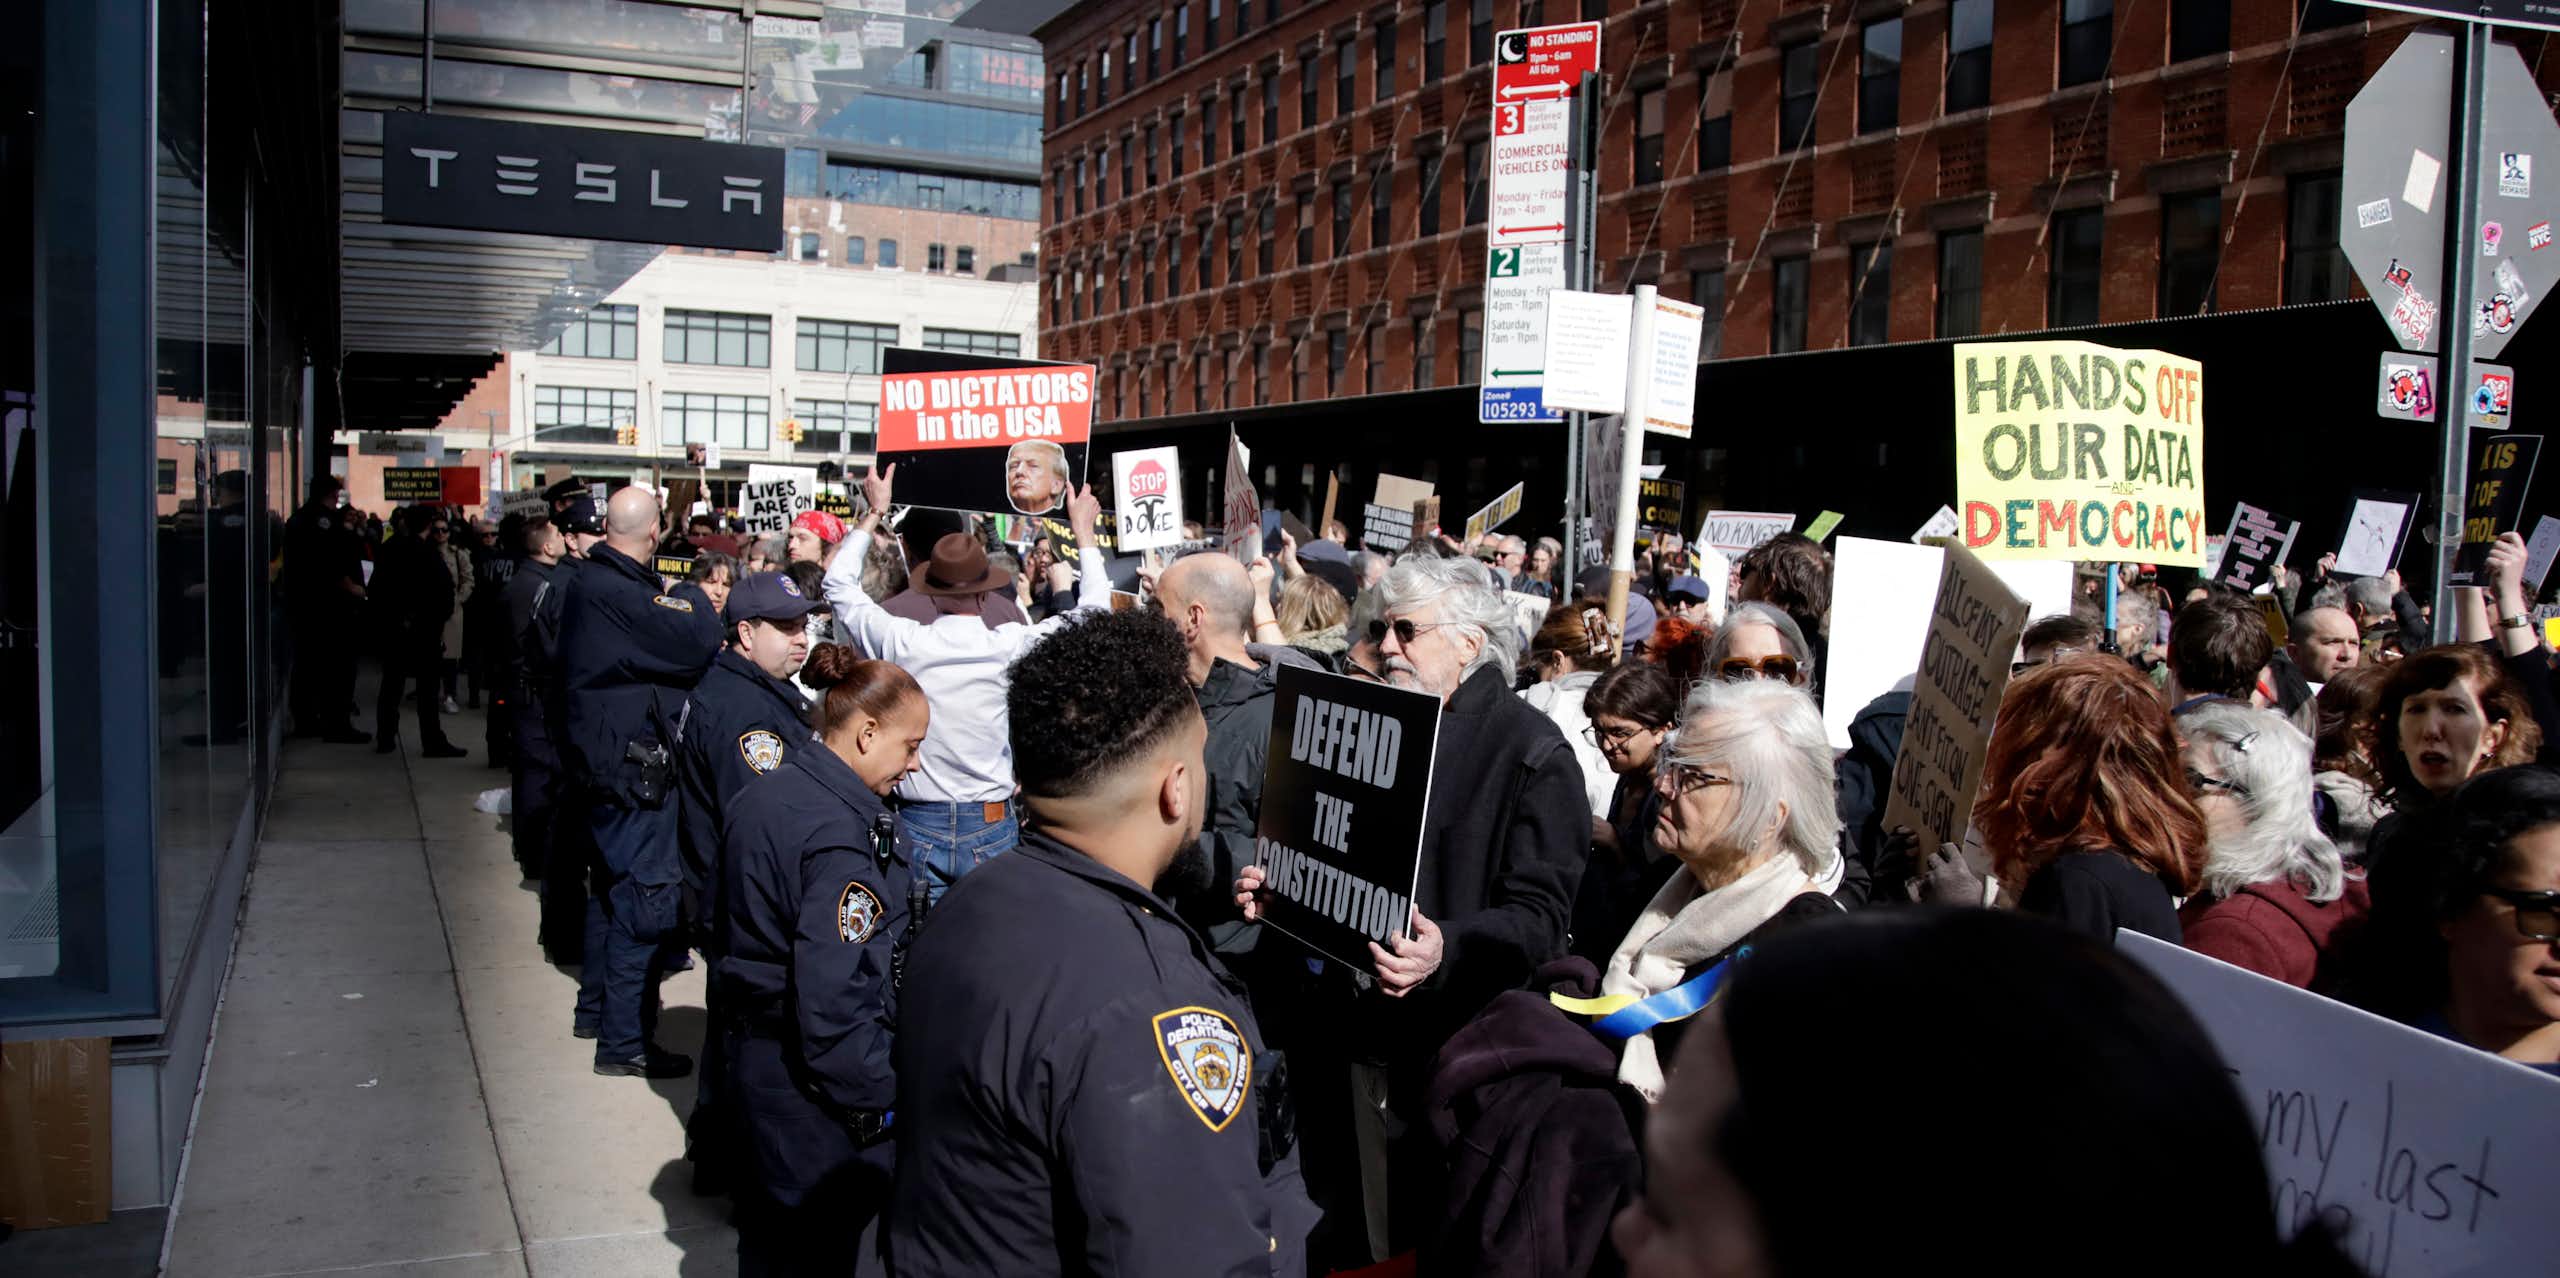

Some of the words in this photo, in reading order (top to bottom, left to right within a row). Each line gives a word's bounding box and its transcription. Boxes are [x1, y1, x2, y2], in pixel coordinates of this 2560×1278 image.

[1530, 36, 1544, 47] NO
[1546, 30, 1593, 45] STANDING
[1530, 51, 1548, 62] 11pm
[1554, 50, 1572, 61] 6am
[1529, 64, 1540, 75] All
[1541, 63, 1560, 75] Days
[1502, 106, 1519, 134] 3
[1528, 112, 1562, 122] metered
[1528, 121, 1558, 133] parking
[1498, 143, 1568, 160] COMMERCIAL
[1498, 160, 1548, 176] VEHICLES
[410, 146, 763, 216] TESLA
[1496, 191, 1531, 204] Monday
[1540, 188, 1568, 201] Friday
[1497, 204, 1516, 216] 7am
[1526, 203, 1545, 216] 4pm
[2530, 230, 2552, 249] NYC
[1496, 248, 1514, 275] 2
[1523, 255, 1557, 265] metered
[1523, 265, 1553, 276] parking
[1493, 287, 1527, 299] Monday
[1536, 287, 1550, 297] Fri
[1492, 301, 1513, 312] 4pm
[1521, 299, 1543, 312] 11pm
[1491, 319, 1531, 332] Saturday
[1490, 332, 1509, 344] 7am
[1517, 332, 1539, 344] 11pm
[885, 377, 925, 411] NO
[931, 371, 1089, 408] DICTATORS
[1965, 353, 2147, 415] HANDS
[2156, 364, 2199, 425] OFF
[1483, 402, 1537, 418] 105293
[916, 411, 945, 442] in
[951, 409, 999, 440] the
[1005, 405, 1063, 436] USA
[1983, 422, 2108, 481] OUR
[2124, 424, 2194, 490] DATA
[2492, 442, 2518, 470] IS
[747, 479, 797, 500] LIVES
[1130, 471, 1166, 492] STOP
[753, 498, 790, 517] ARE
[795, 495, 812, 510] ON
[747, 514, 782, 534] THE
[1124, 511, 1174, 534] DOGE
[1704, 520, 1729, 542] NO
[1965, 500, 2201, 553] DEMOCRACY
[658, 559, 682, 572] MUSK
[1937, 561, 1967, 628] ALL
[1962, 596, 1984, 638] OF
[1973, 604, 2003, 658] MY
[1925, 630, 1992, 728] OUTRAGE
[1290, 694, 1402, 790] DEFEND
[1897, 748, 1926, 809] ONE
[1313, 791, 1354, 853] THE
[1255, 835, 1408, 946] CONSTITUTION
[1180, 1013, 1224, 1030] POLICE
[1166, 1026, 1240, 1047] DEPARTMENT
[1234, 1053, 1247, 1088] YORK
[1172, 1059, 1195, 1089] CITY
[1191, 1089, 1209, 1109] OF
[2262, 1088, 2348, 1208] my
[2374, 1079, 2500, 1233] last
